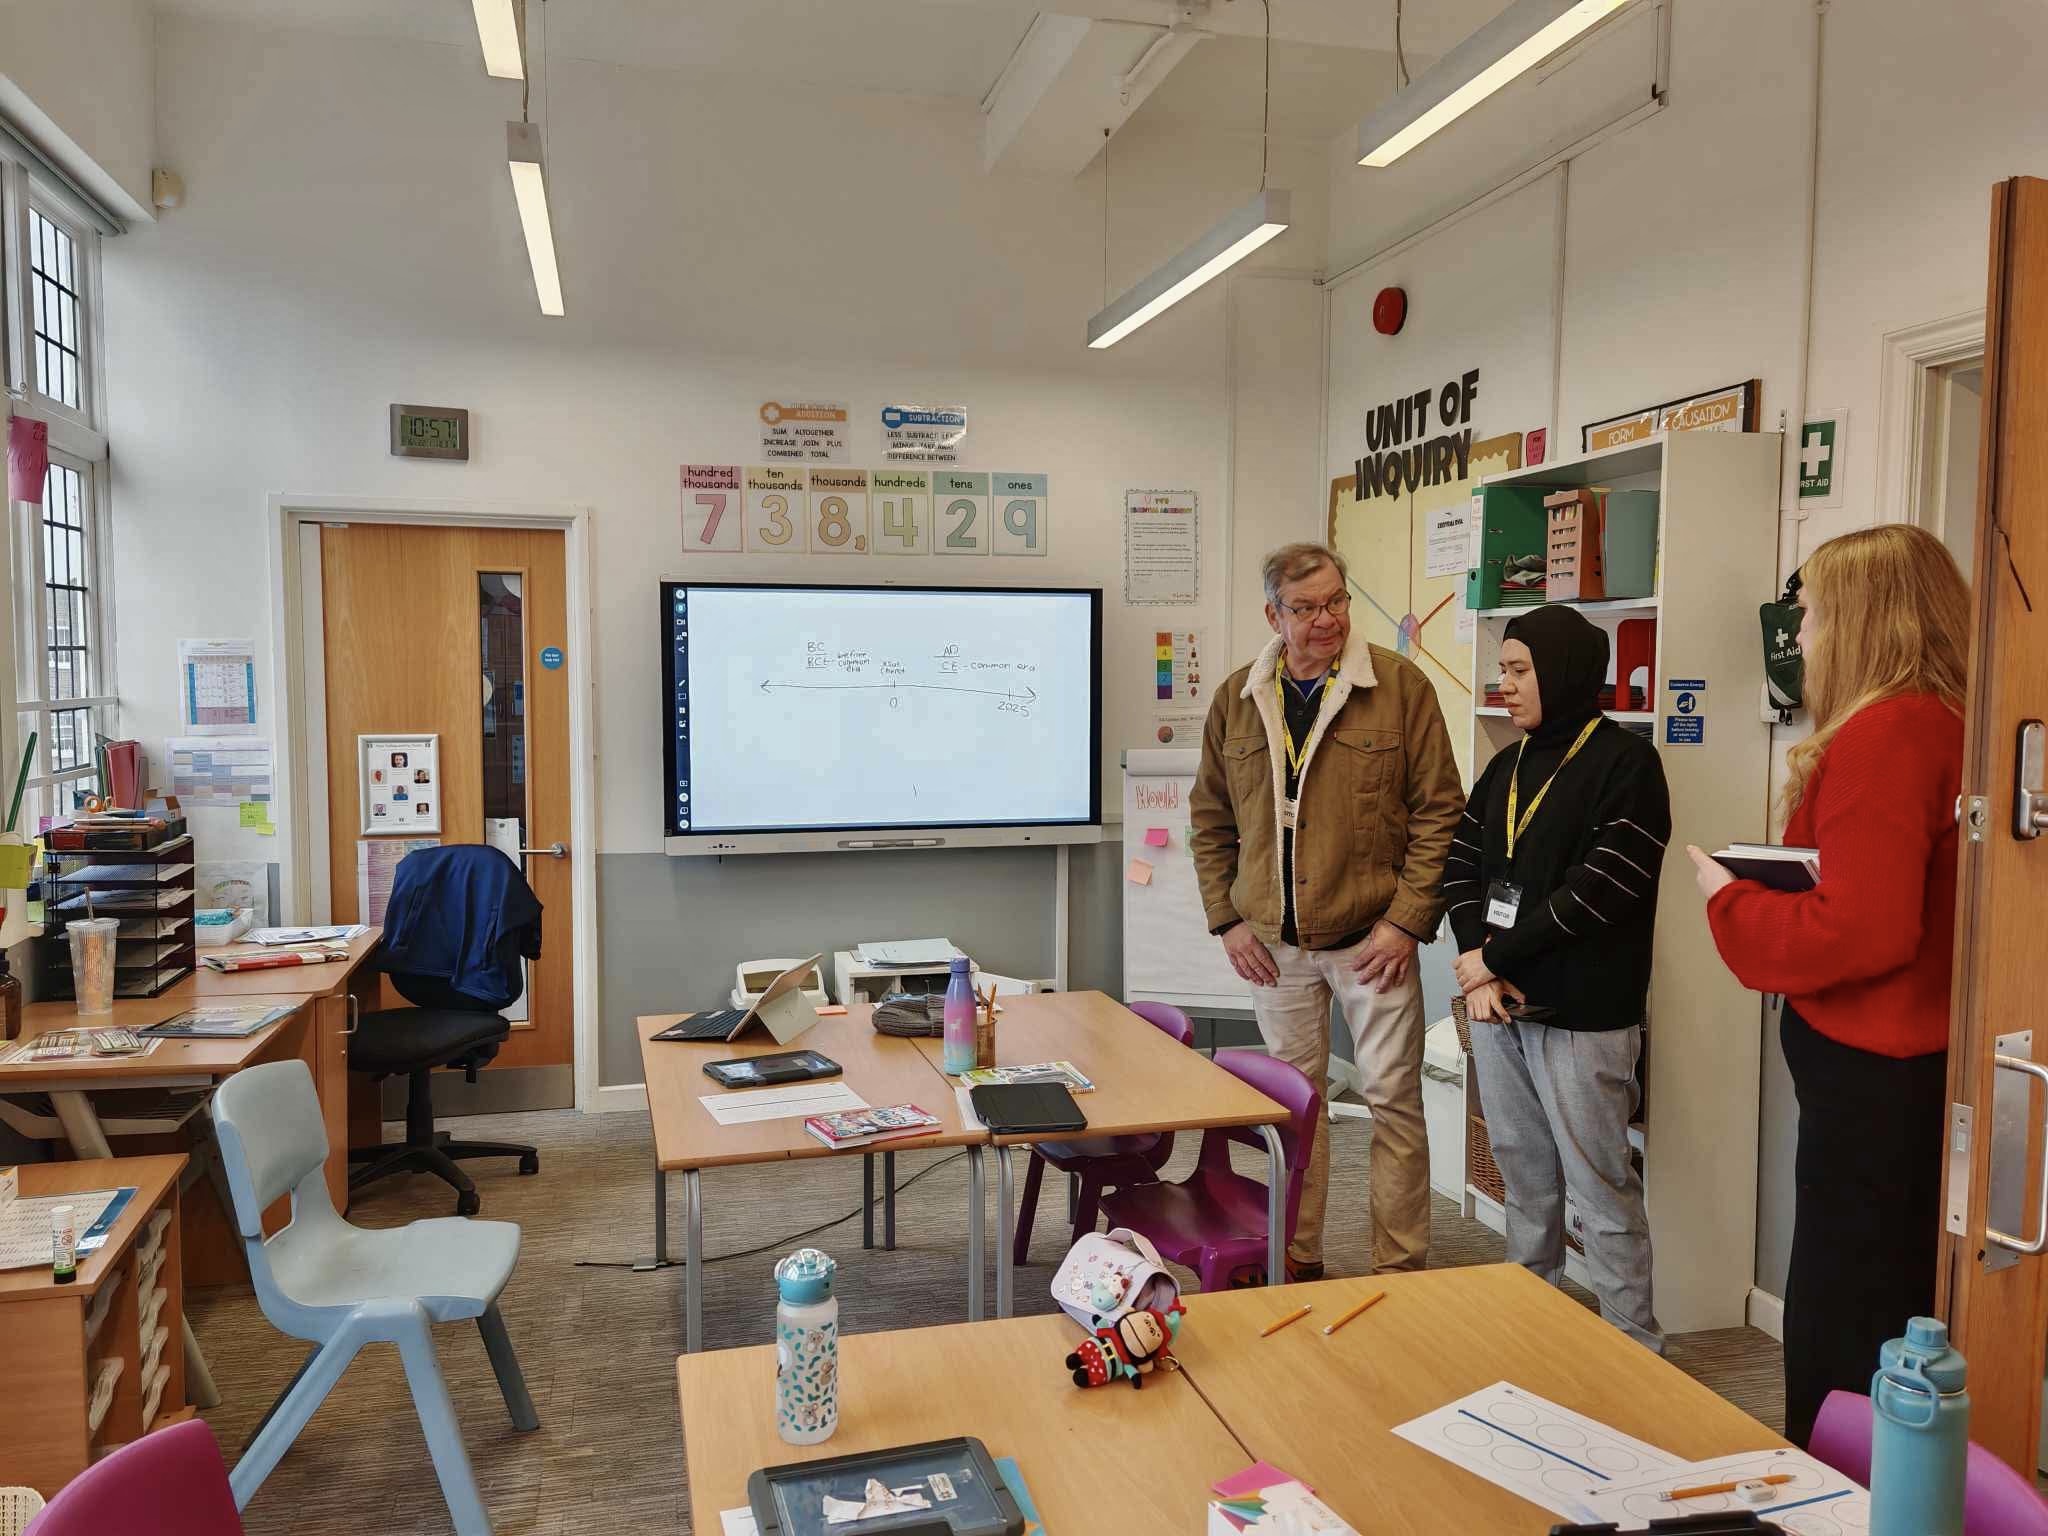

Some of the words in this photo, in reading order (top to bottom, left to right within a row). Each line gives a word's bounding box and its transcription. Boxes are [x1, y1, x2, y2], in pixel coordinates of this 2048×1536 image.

[1366, 388, 1431, 452] UNIT
[1440, 368, 1479, 427] OF
[1672, 402, 1732, 430] CAUSATION
[909, 414, 960, 423] SUBTRACTION
[409, 418, 451, 439] 10:57
[1608, 426, 1634, 446] FORM
[688, 467, 733, 478] hundred
[1355, 428, 1472, 502] INQUIRY
[766, 468, 784, 478] ten
[811, 473, 866, 487] thousands
[683, 477, 739, 490] thousands
[748, 480, 803, 491] thousands
[874, 474, 926, 489] hundreds
[949, 478, 973, 489] tens
[1007, 481, 1033, 490] ones
[1801, 479, 1815, 488] RST
[1817, 478, 1829, 487] AID
[695, 493, 727, 545] 7
[759, 494, 793, 546] 3
[883, 497, 918, 547] 4
[945, 499, 977, 548] 2
[1003, 499, 1036, 548] 9
[807, 641, 825, 652] BC
[1771, 651, 1785, 661] First
[1787, 646, 1801, 657] Aid
[970, 662, 1010, 670] common
[1016, 663, 1036, 672] era
[997, 701, 1030, 718] 2025
